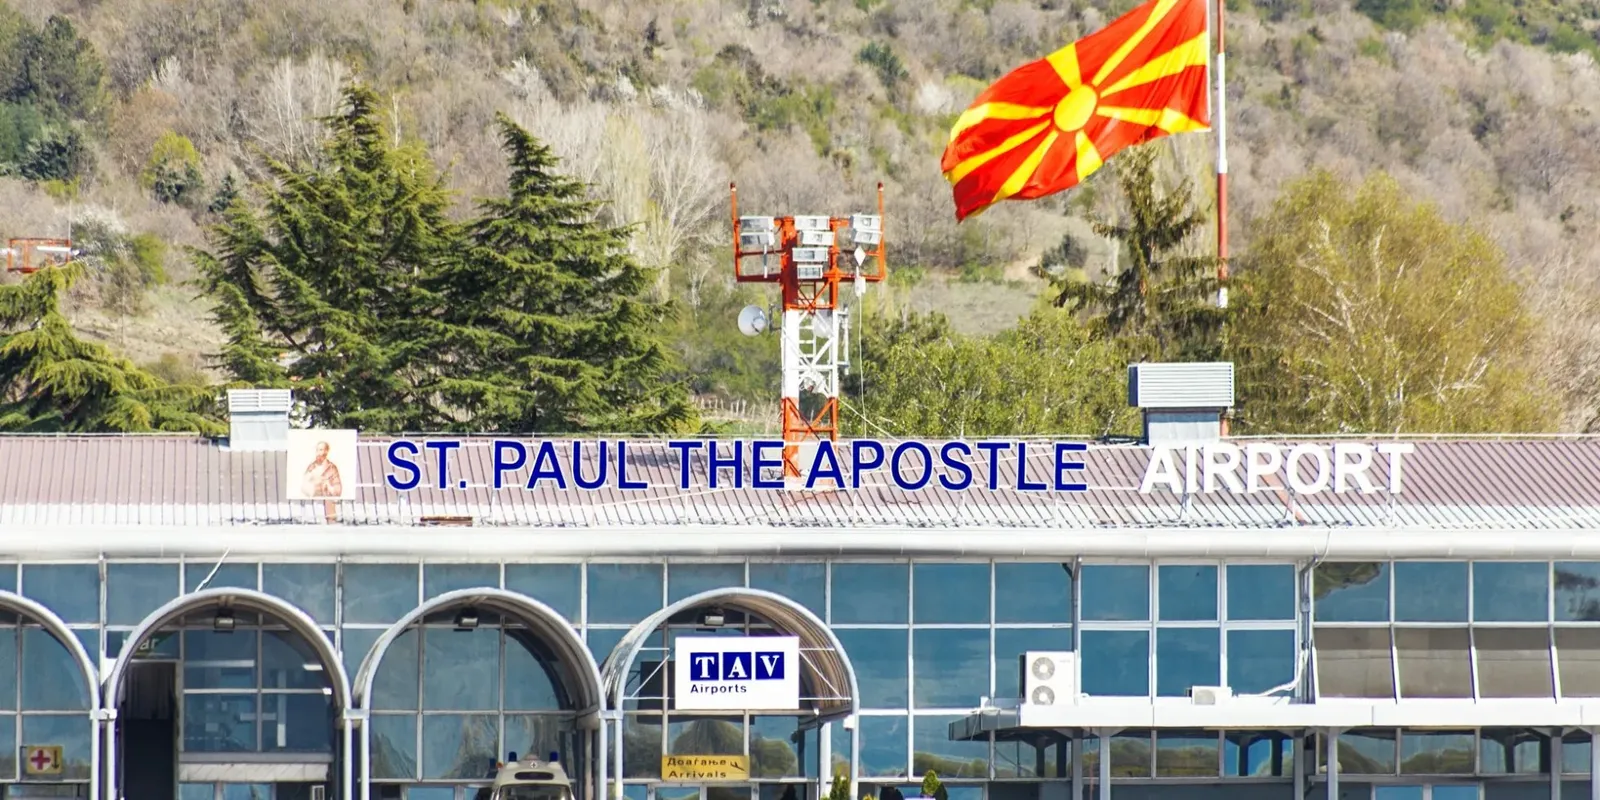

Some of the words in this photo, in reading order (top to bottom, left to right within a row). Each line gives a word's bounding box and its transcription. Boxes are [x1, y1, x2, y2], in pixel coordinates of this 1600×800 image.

[386, 440, 467, 490] ST.
[493, 440, 648, 490] PAUL
[668, 441, 785, 489] THE
[805, 440, 1088, 491] APOSTLE
[1140, 443, 1414, 494] AIRPORT
[694, 654, 781, 679] TAV
[690, 684, 747, 695] Airports
[668, 770, 727, 778] Arrivals
